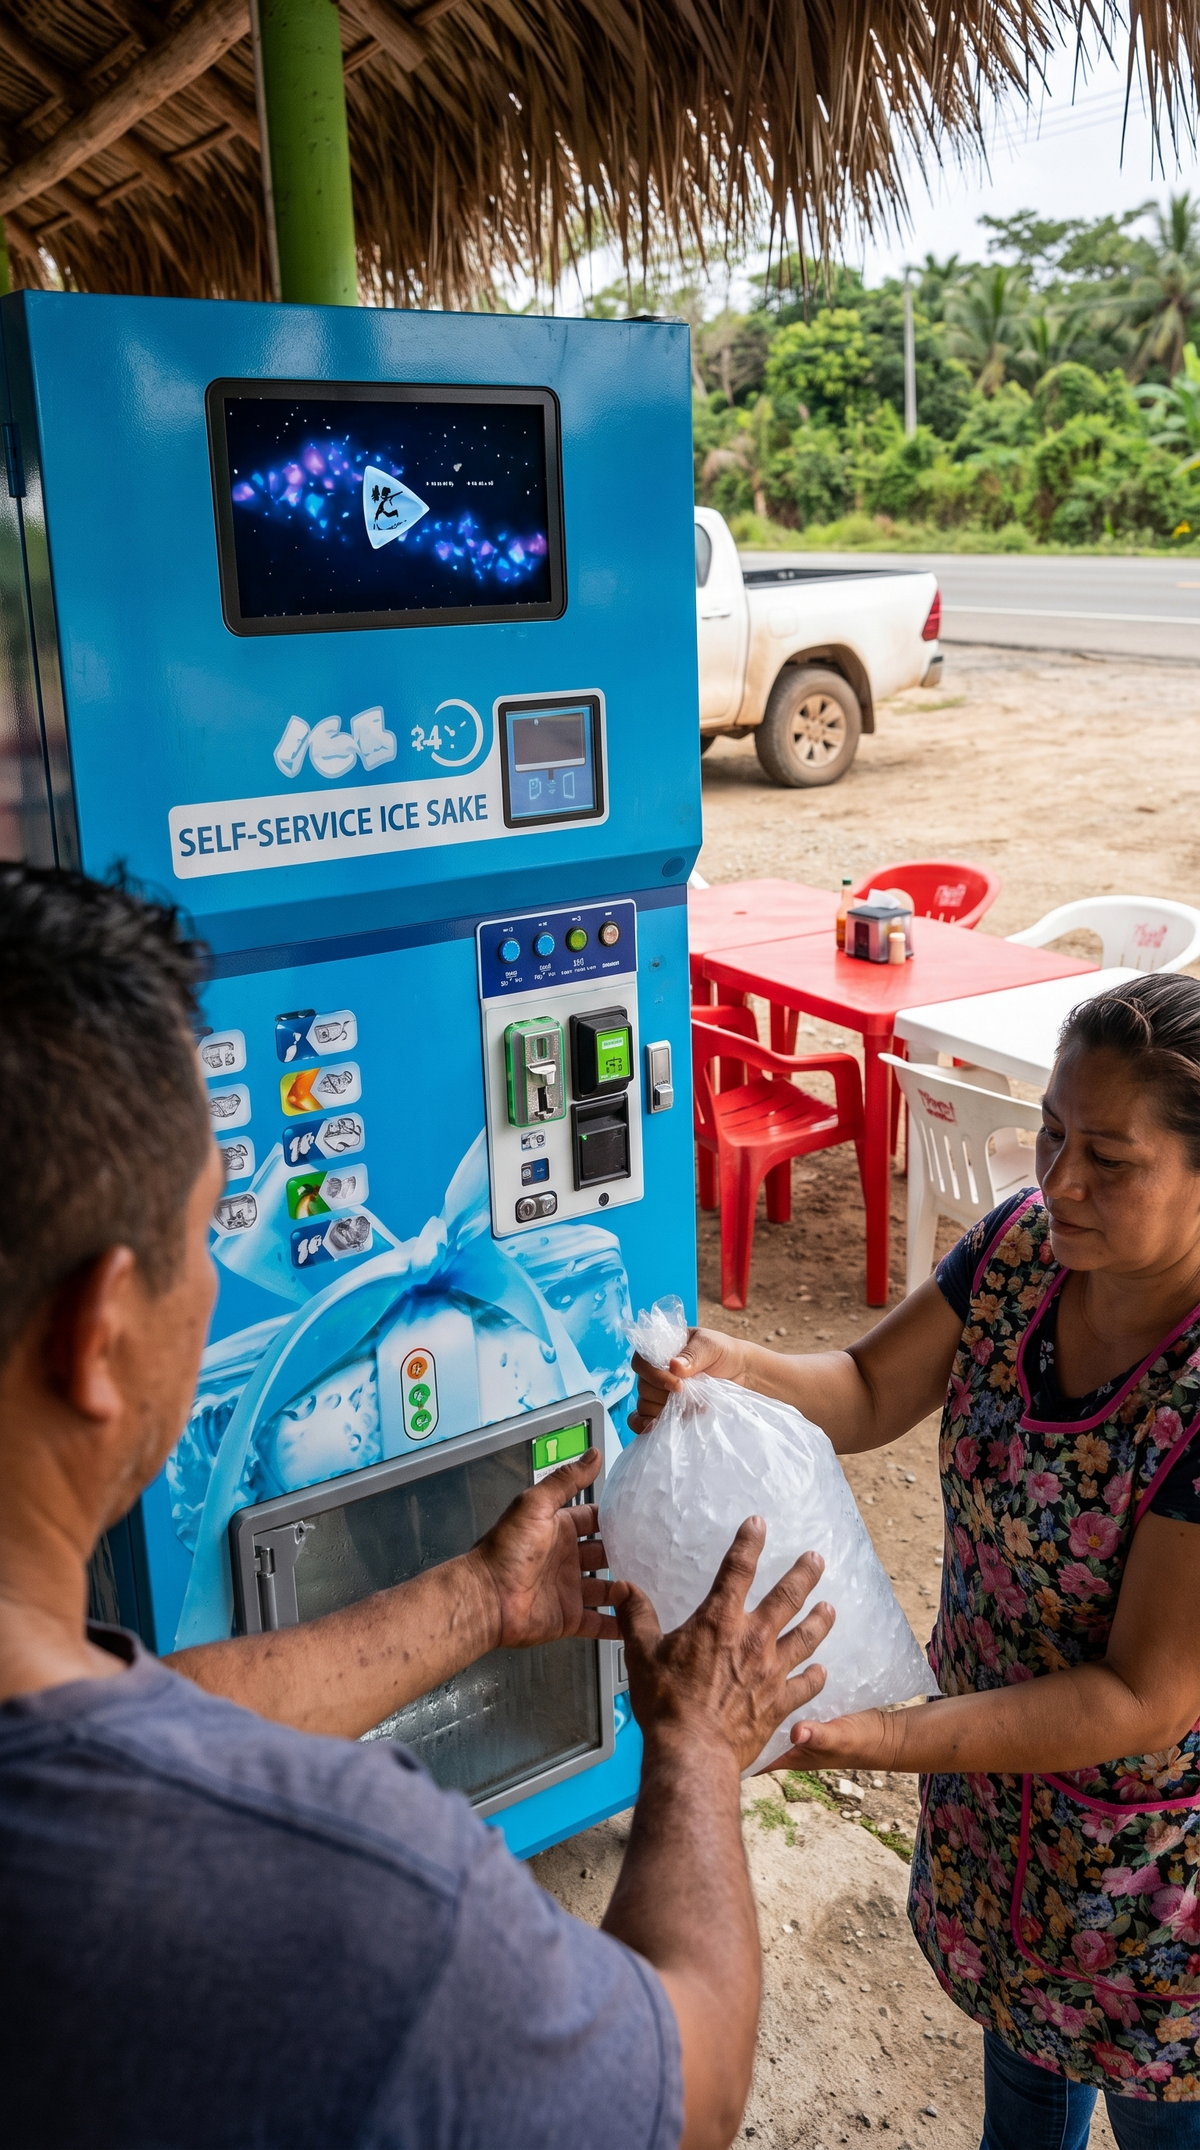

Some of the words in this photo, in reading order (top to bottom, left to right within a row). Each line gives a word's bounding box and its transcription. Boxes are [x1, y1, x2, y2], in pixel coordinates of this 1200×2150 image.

[410, 724, 442, 752] 24
[178, 807, 373, 857] SELF-SERVICE
[380, 801, 420, 833] ICE
[426, 793, 488, 827] SAKE
